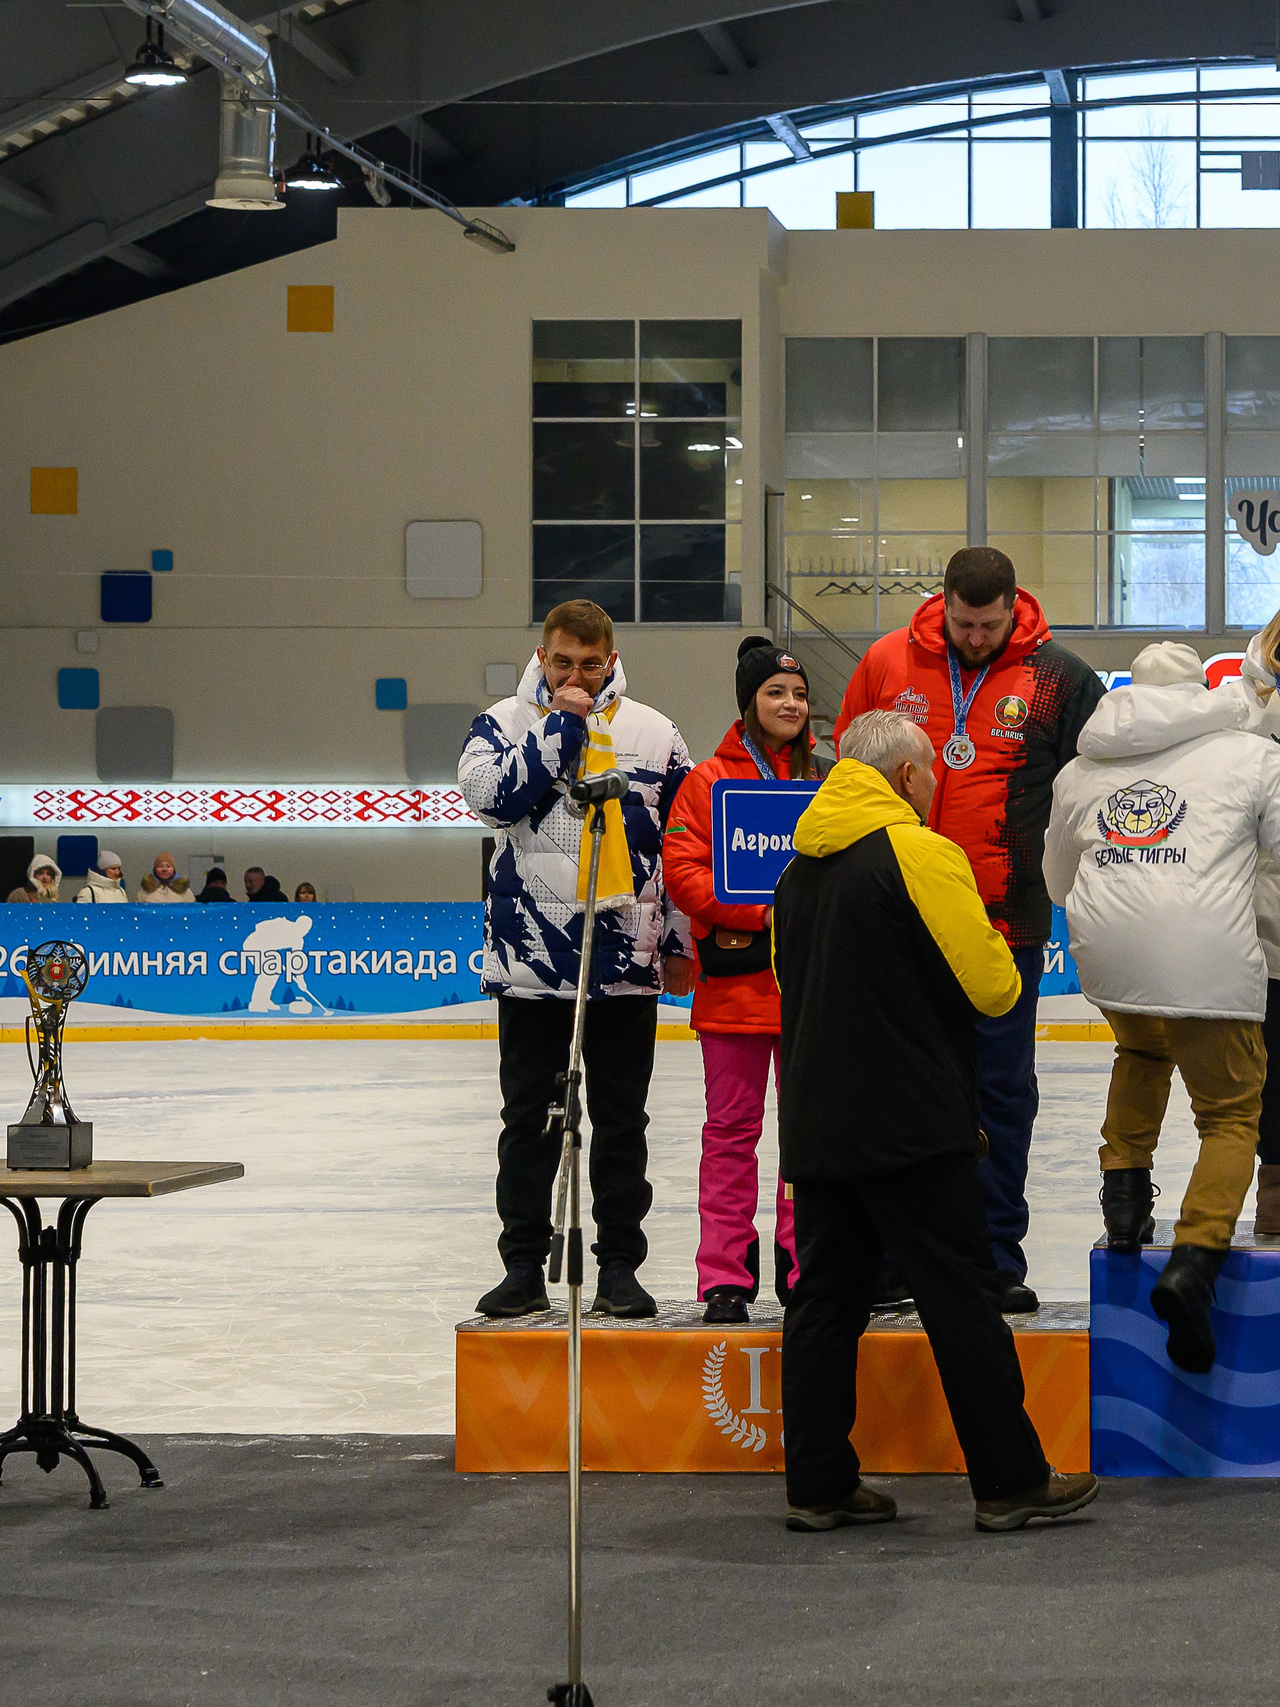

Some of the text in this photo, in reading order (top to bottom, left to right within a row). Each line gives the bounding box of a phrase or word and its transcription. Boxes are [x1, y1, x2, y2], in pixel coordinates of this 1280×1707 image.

[990, 728, 1025, 741] BELARUS
[731, 827, 798, 858] Агрох
[1095, 847, 1187, 868] БЕЛЫЕ ТИГРЫ
[218, 947, 458, 983] спартакиада
